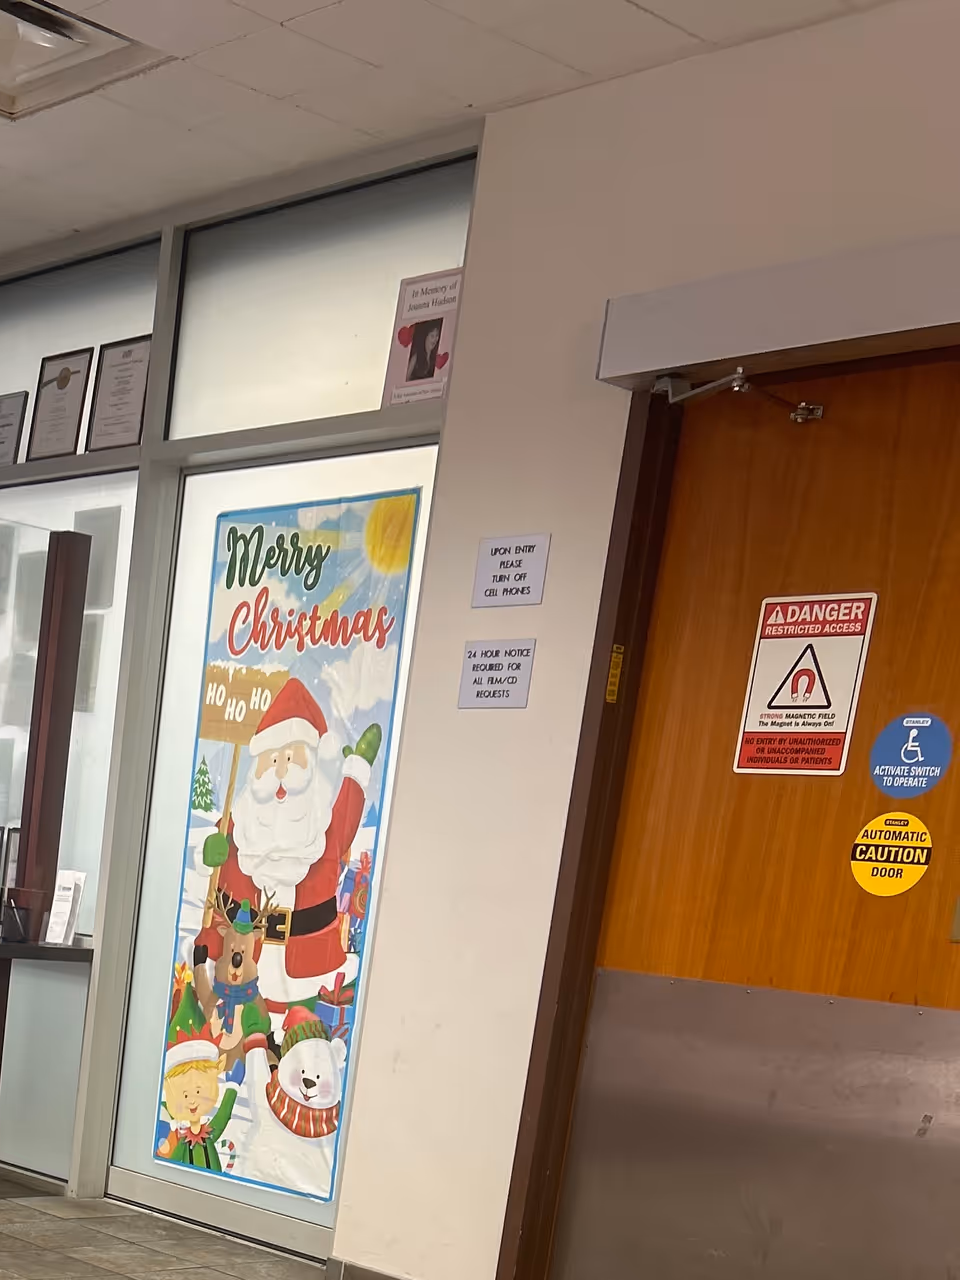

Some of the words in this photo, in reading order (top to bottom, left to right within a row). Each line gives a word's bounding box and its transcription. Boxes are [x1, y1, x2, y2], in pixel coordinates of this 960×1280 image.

[420, 284, 448, 297] Memory
[490, 546, 511, 556] UPON
[515, 544, 536, 554] ENTRY
[225, 524, 331, 591] Merry
[499, 559, 523, 569] PLEASE
[492, 574, 511, 583] TURN
[514, 572, 527, 581] OFF
[484, 588, 498, 597] CELL
[502, 586, 531, 597] PHONES
[786, 602, 865, 623] DANGER
[227, 586, 395, 656] Christmas
[765, 624, 822, 635] RESTRICTED
[823, 622, 862, 633] ACCESS
[467, 650, 477, 659] 24
[480, 649, 500, 658] HOUR
[504, 648, 531, 657] NOTICE
[472, 663, 504, 672] REQUIRED
[507, 662, 521, 671] FOR
[472, 677, 483, 685] ALL
[487, 676, 518, 685] FILM/CD
[476, 689, 510, 698] REQUESTS
[205, 682, 226, 707] HO
[224, 697, 247, 722] HO
[249, 687, 272, 712] HO
[801, 720, 822, 728] Always
[745, 737, 754, 745] NO
[756, 737, 776, 745] ENTRY
[778, 737, 787, 745] BY
[788, 737, 841, 746] UNAUTHORIZED
[767, 747, 826, 755] UNACCOMPANIED
[746, 756, 788, 764] INDIVIDUALS
[800, 757, 832, 765] PATIENTS
[873, 765, 910, 776] ACTIVATE
[910, 766, 941, 777] SWITCH
[883, 776, 893, 786] TO
[893, 777, 928, 787] OPERATE
[861, 829, 928, 842] AUTOMATIC
[855, 845, 928, 863] CAUTION
[871, 866, 904, 879] DOOR
